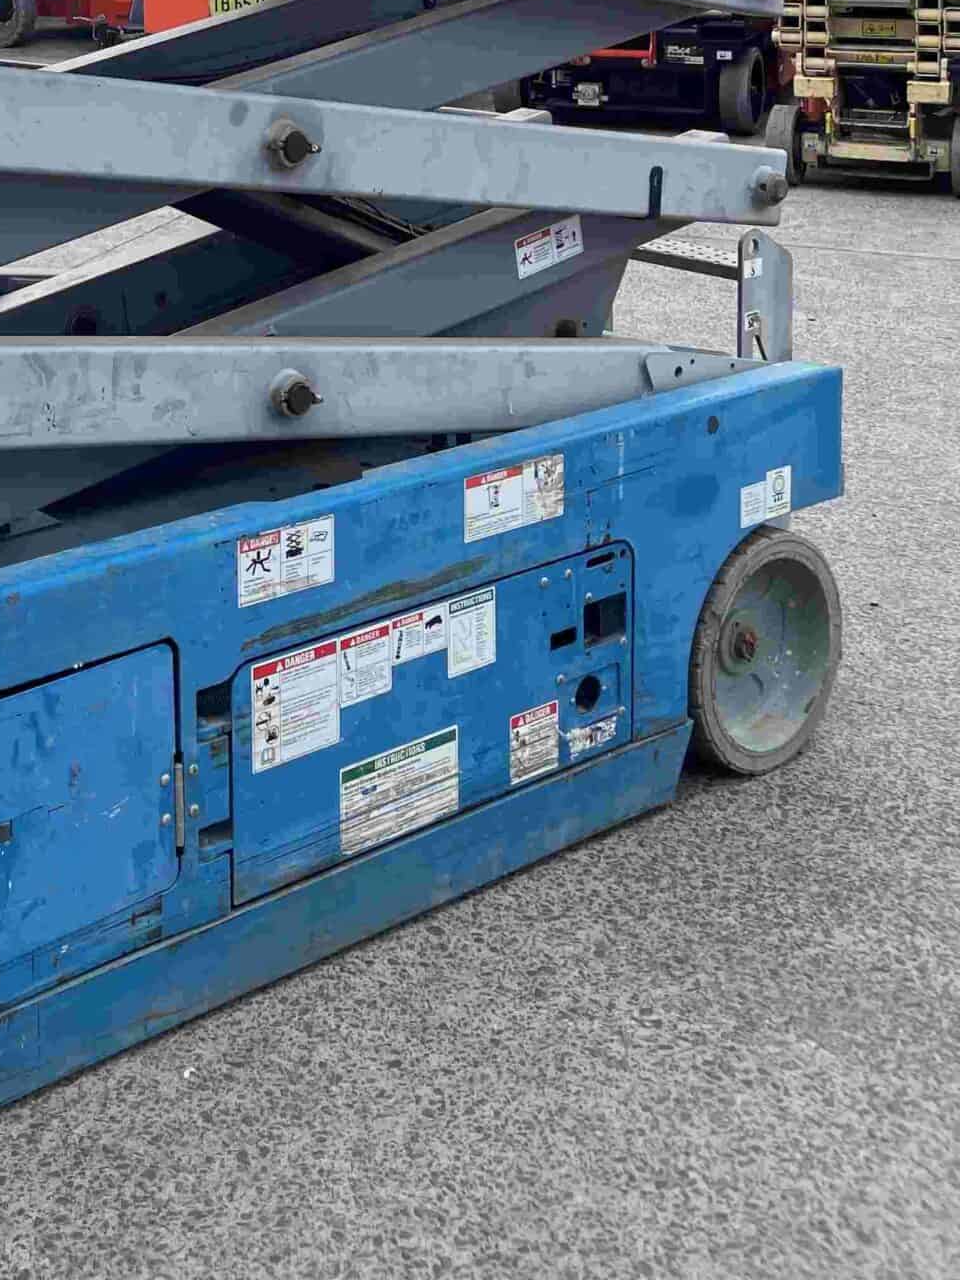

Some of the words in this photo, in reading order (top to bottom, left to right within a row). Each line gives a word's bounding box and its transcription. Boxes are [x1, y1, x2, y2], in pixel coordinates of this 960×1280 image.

[356, 630, 380, 645] DANGER
[284, 650, 315, 668] DANGER
[374, 742, 426, 769] INSTRUCTIONS
